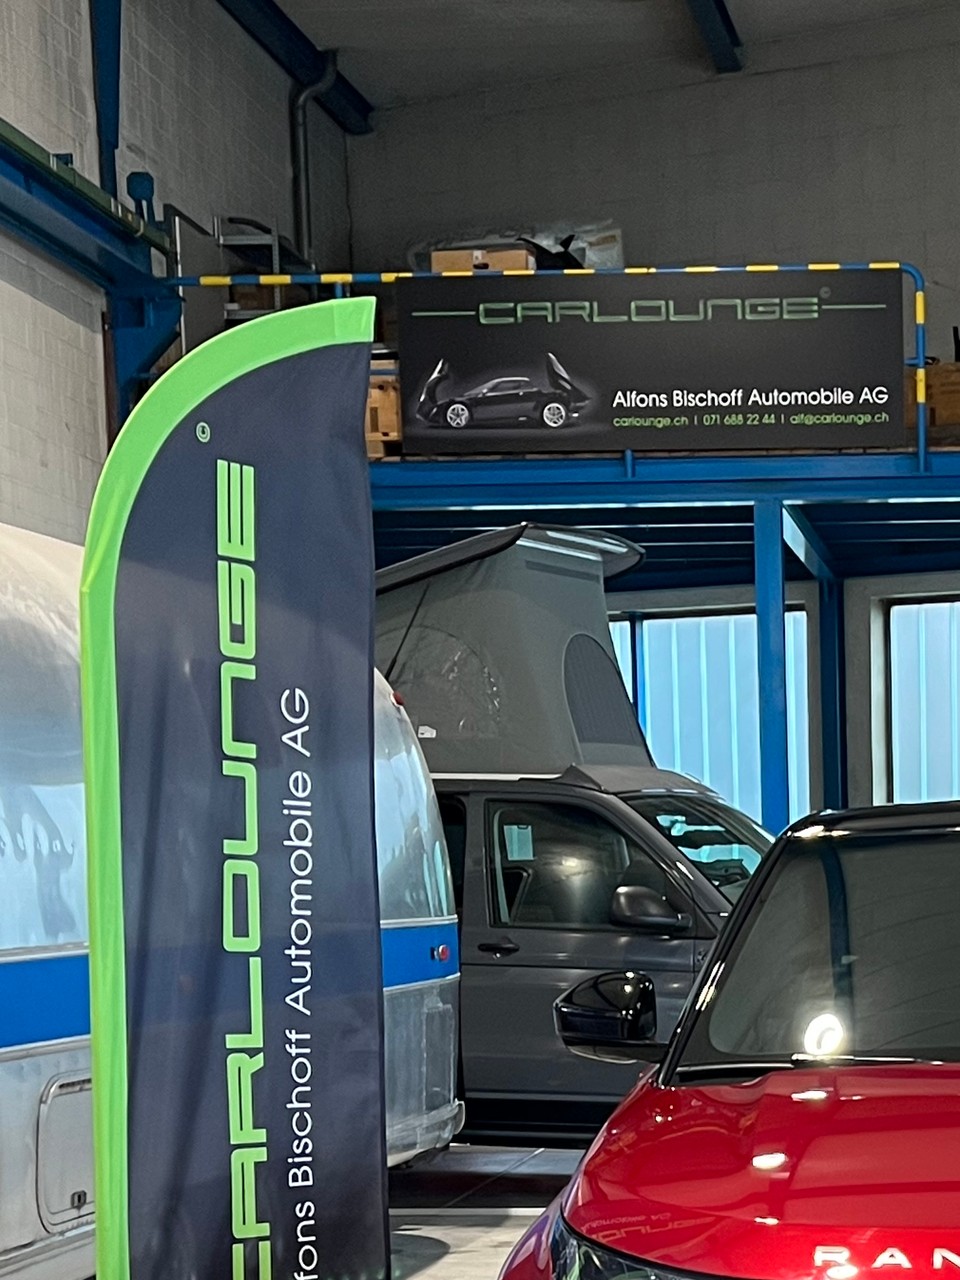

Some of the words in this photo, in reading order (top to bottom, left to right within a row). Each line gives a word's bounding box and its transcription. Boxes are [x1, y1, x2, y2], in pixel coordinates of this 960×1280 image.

[478, 297, 819, 324] CARLOUNGE
[612, 390, 668, 408] Alfons
[672, 388, 743, 407] Bischoff
[747, 387, 854, 406] Automobile
[859, 386, 889, 404] AG
[612, 415, 689, 428] carlounge.ch
[702, 414, 721, 426] 071
[723, 414, 744, 426] 688
[746, 413, 760, 425] 22
[762, 413, 776, 424] 44
[789, 412, 889, 426] alf@carlounge.ch
[280, 686, 311, 758] AG
[283, 769, 313, 1016] Automobile
[285, 1028, 314, 1189] Bischoff
